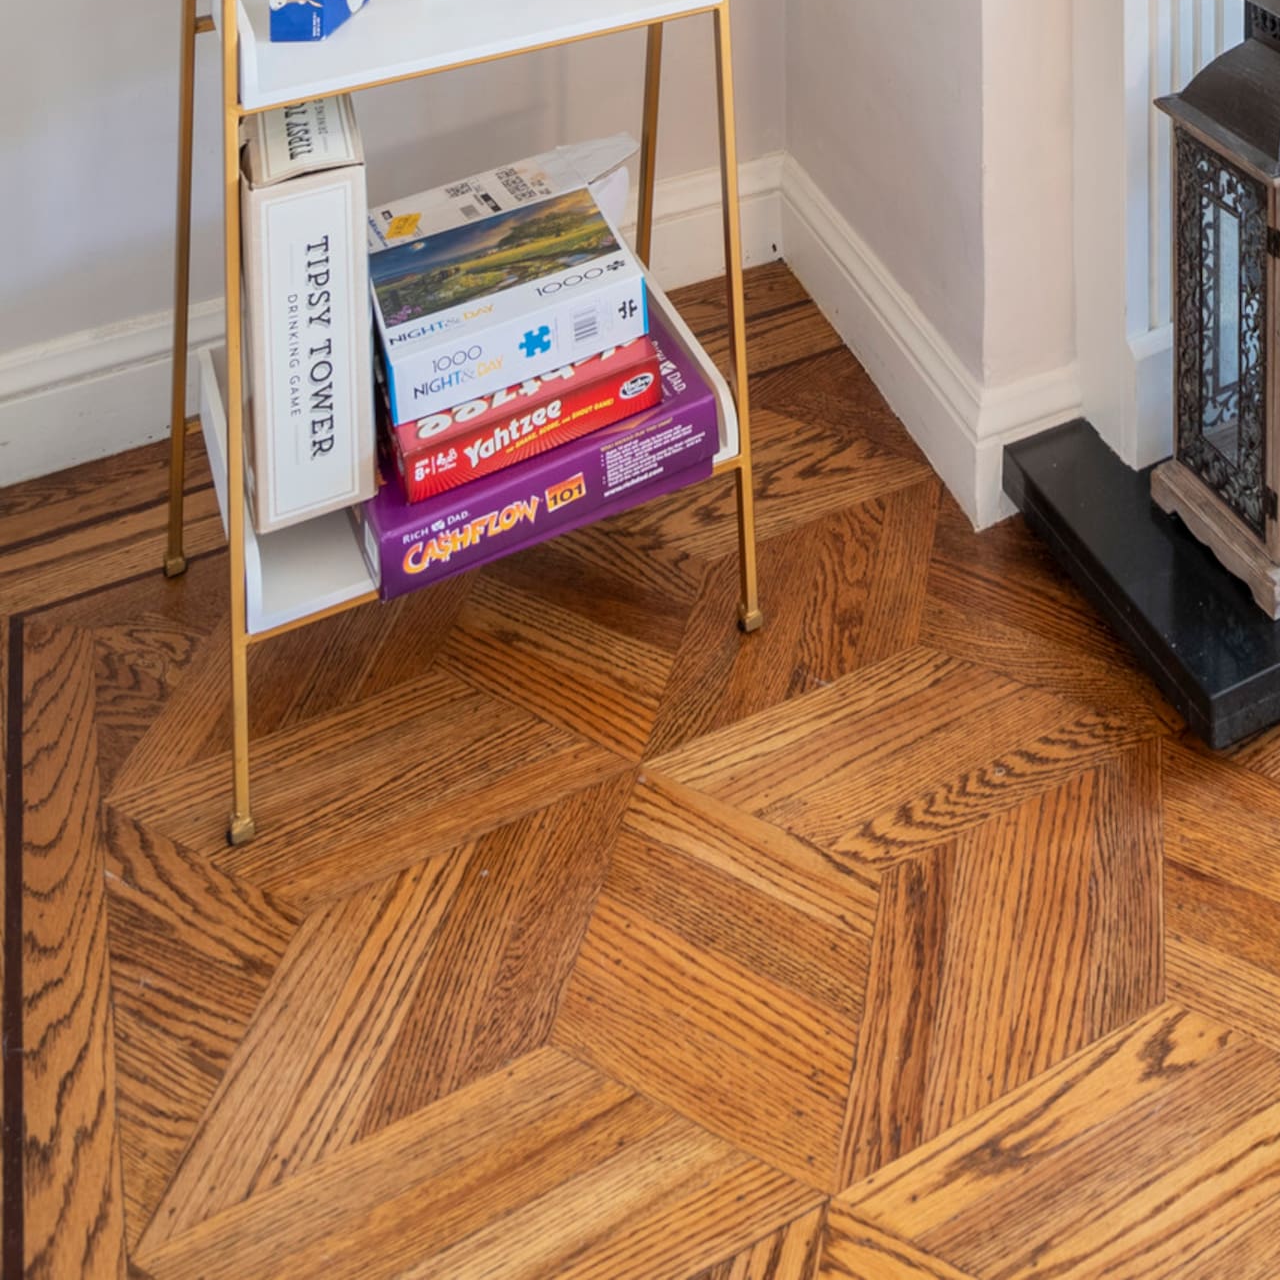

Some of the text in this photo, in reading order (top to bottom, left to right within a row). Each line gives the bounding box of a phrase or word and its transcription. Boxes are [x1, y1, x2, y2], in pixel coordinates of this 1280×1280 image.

[535, 268, 604, 297] 1000
[306, 235, 335, 459] TIPSY TOWER
[389, 320, 444, 346] NIGHT
[286, 293, 302, 417] DRINKING GAME
[432, 345, 483, 374] 1000
[413, 370, 461, 399] NIGHT
[476, 354, 504, 378] DAY
[463, 400, 562, 468] Yahtzee
[549, 483, 585, 506] 101
[402, 510, 469, 545] RICH DAD
